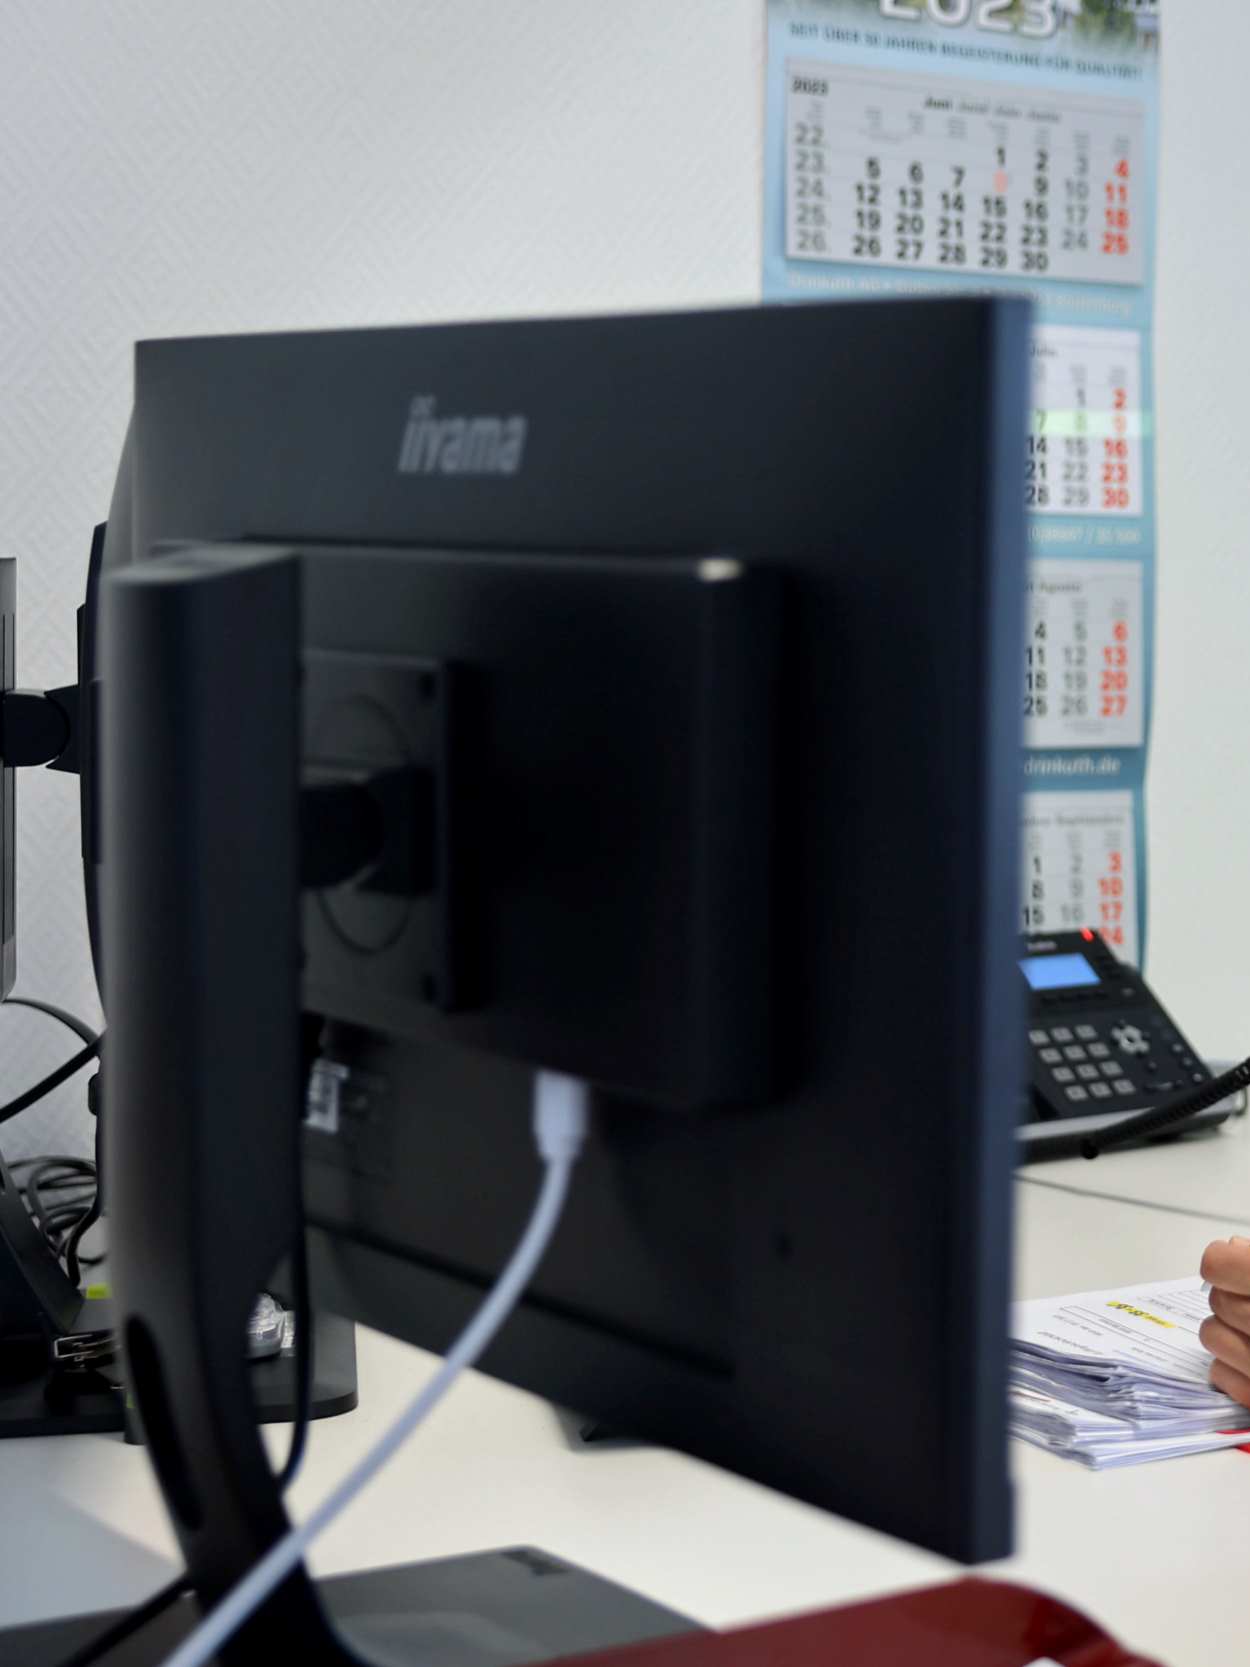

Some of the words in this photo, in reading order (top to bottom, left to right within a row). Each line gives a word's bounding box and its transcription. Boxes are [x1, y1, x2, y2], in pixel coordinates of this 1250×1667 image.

[996, 147, 1005, 167] 1
[1036, 149, 1048, 172] 2
[1114, 159, 1129, 178] 4
[867, 157, 880, 179] 5
[910, 161, 923, 184] 6
[952, 165, 965, 187] 7
[1034, 174, 1048, 196] 9
[1065, 178, 1089, 202] 10
[1105, 180, 1128, 204] 11
[856, 182, 880, 206] 12
[899, 186, 923, 210] 13
[940, 191, 965, 213] 14
[983, 195, 1006, 218] 15
[1024, 199, 1048, 222] 16
[1065, 203, 1089, 226] 17
[1105, 207, 1129, 230] 18
[856, 208, 880, 232] 19
[897, 212, 924, 236] 20
[939, 216, 964, 239] 21
[981, 220, 1006, 243] 22
[1021, 224, 1048, 247] 23
[1062, 227, 1089, 251] 24
[1101, 231, 1130, 255] 25
[854, 234, 881, 258] 26
[897, 238, 923, 261] 27
[939, 242, 966, 265] 28
[981, 245, 1007, 269] 29
[1021, 250, 1048, 272] 30
[1113, 388, 1127, 410] 2
[399, 395, 527, 473] iiyama
[1027, 437, 1047, 456] 14
[1104, 438, 1128, 459] 16
[1025, 460, 1047, 480] 21
[1062, 461, 1088, 483] 22
[1102, 463, 1128, 484] 23
[1025, 484, 1049, 506] 28
[1102, 486, 1130, 509] 30
[1035, 620, 1047, 641] 4
[1113, 619, 1127, 642] 6
[1025, 646, 1046, 667] 11
[1063, 646, 1087, 668] 12
[1103, 646, 1127, 668] 13
[1025, 671, 1048, 692] 18
[1100, 671, 1128, 693] 20
[1024, 696, 1048, 718] 25
[1061, 696, 1089, 718] 26
[1099, 696, 1128, 718] 27
[1108, 851, 1122, 873] 3
[1098, 877, 1123, 896] 10
[1024, 903, 1045, 925] 15
[1099, 902, 1123, 921] 17
